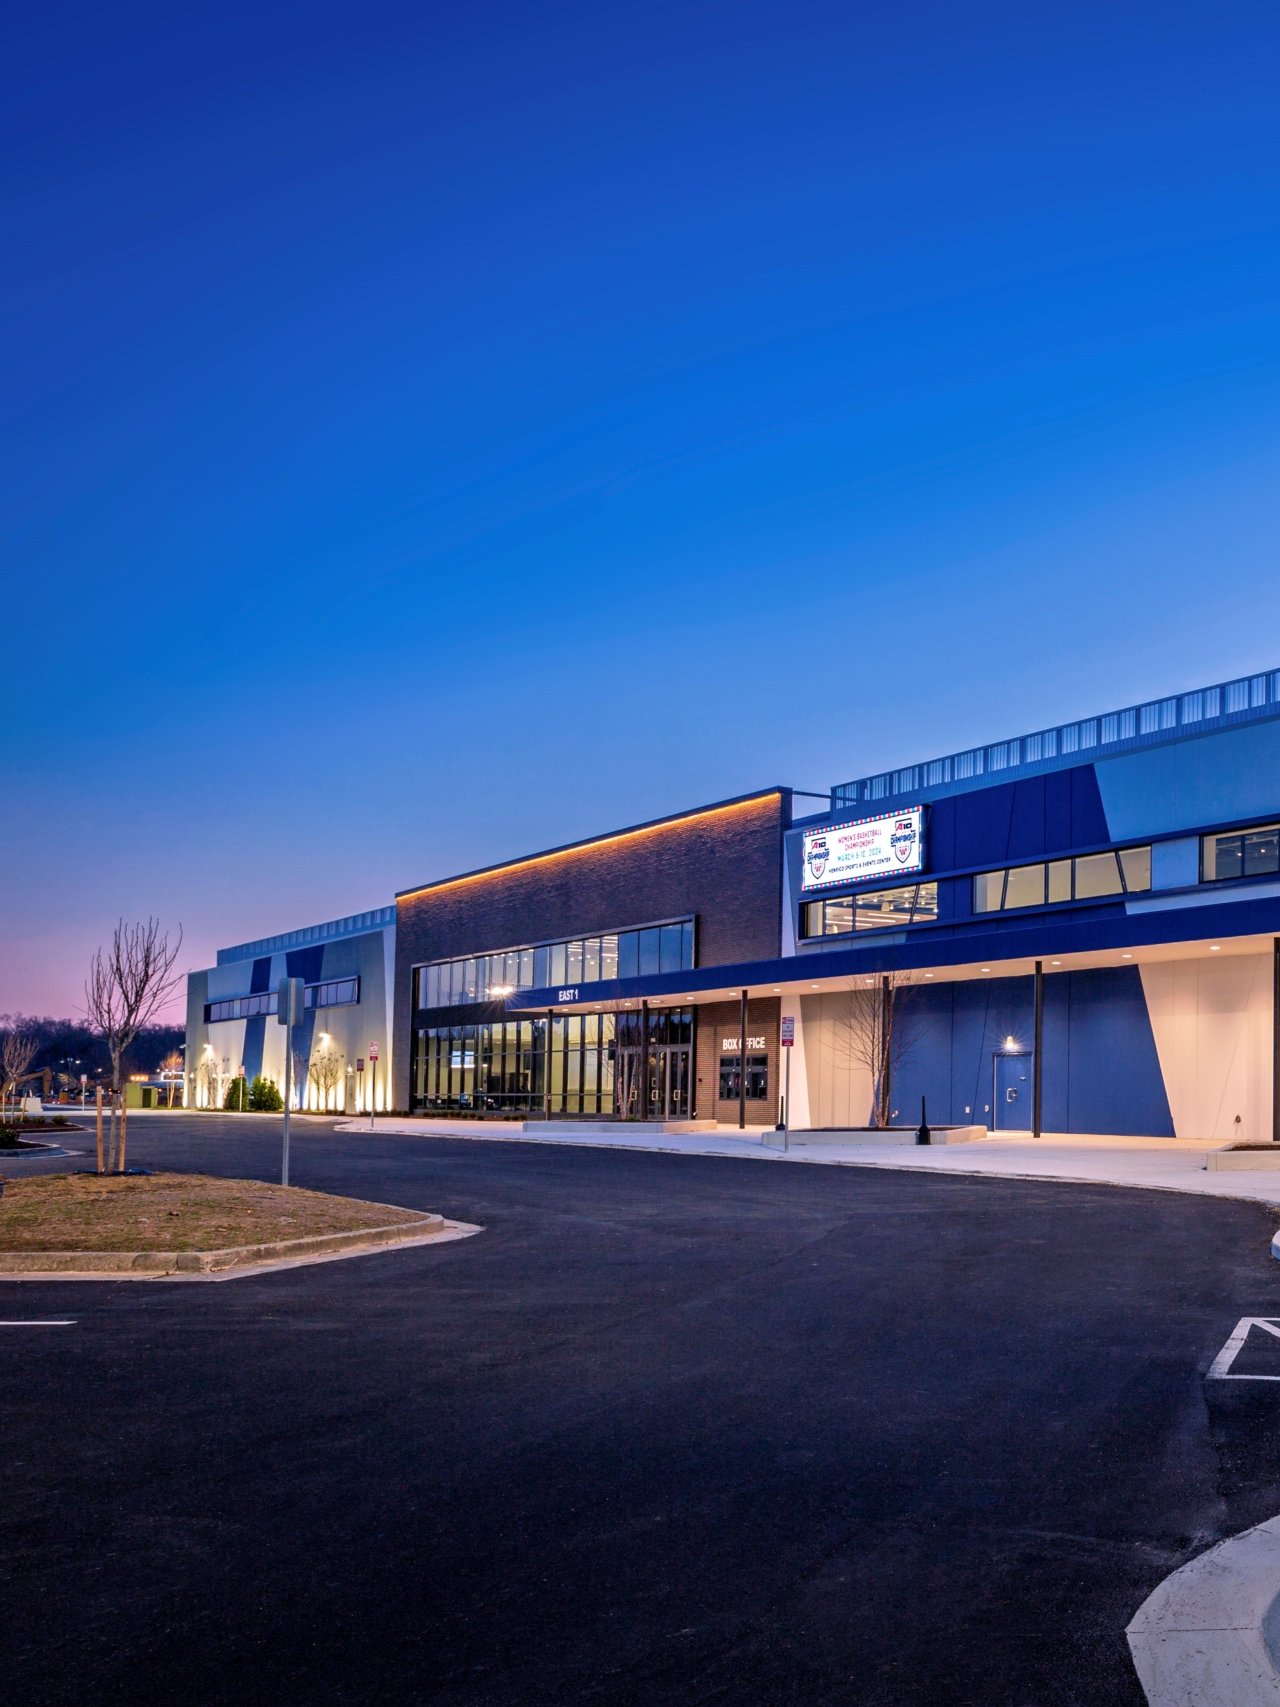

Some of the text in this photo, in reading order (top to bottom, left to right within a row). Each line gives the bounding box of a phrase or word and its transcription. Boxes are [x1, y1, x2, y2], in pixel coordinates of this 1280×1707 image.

[837, 852, 854, 861] MARCH
[559, 988, 578, 1001] EAST 1
[722, 1039, 737, 1049] BOX
